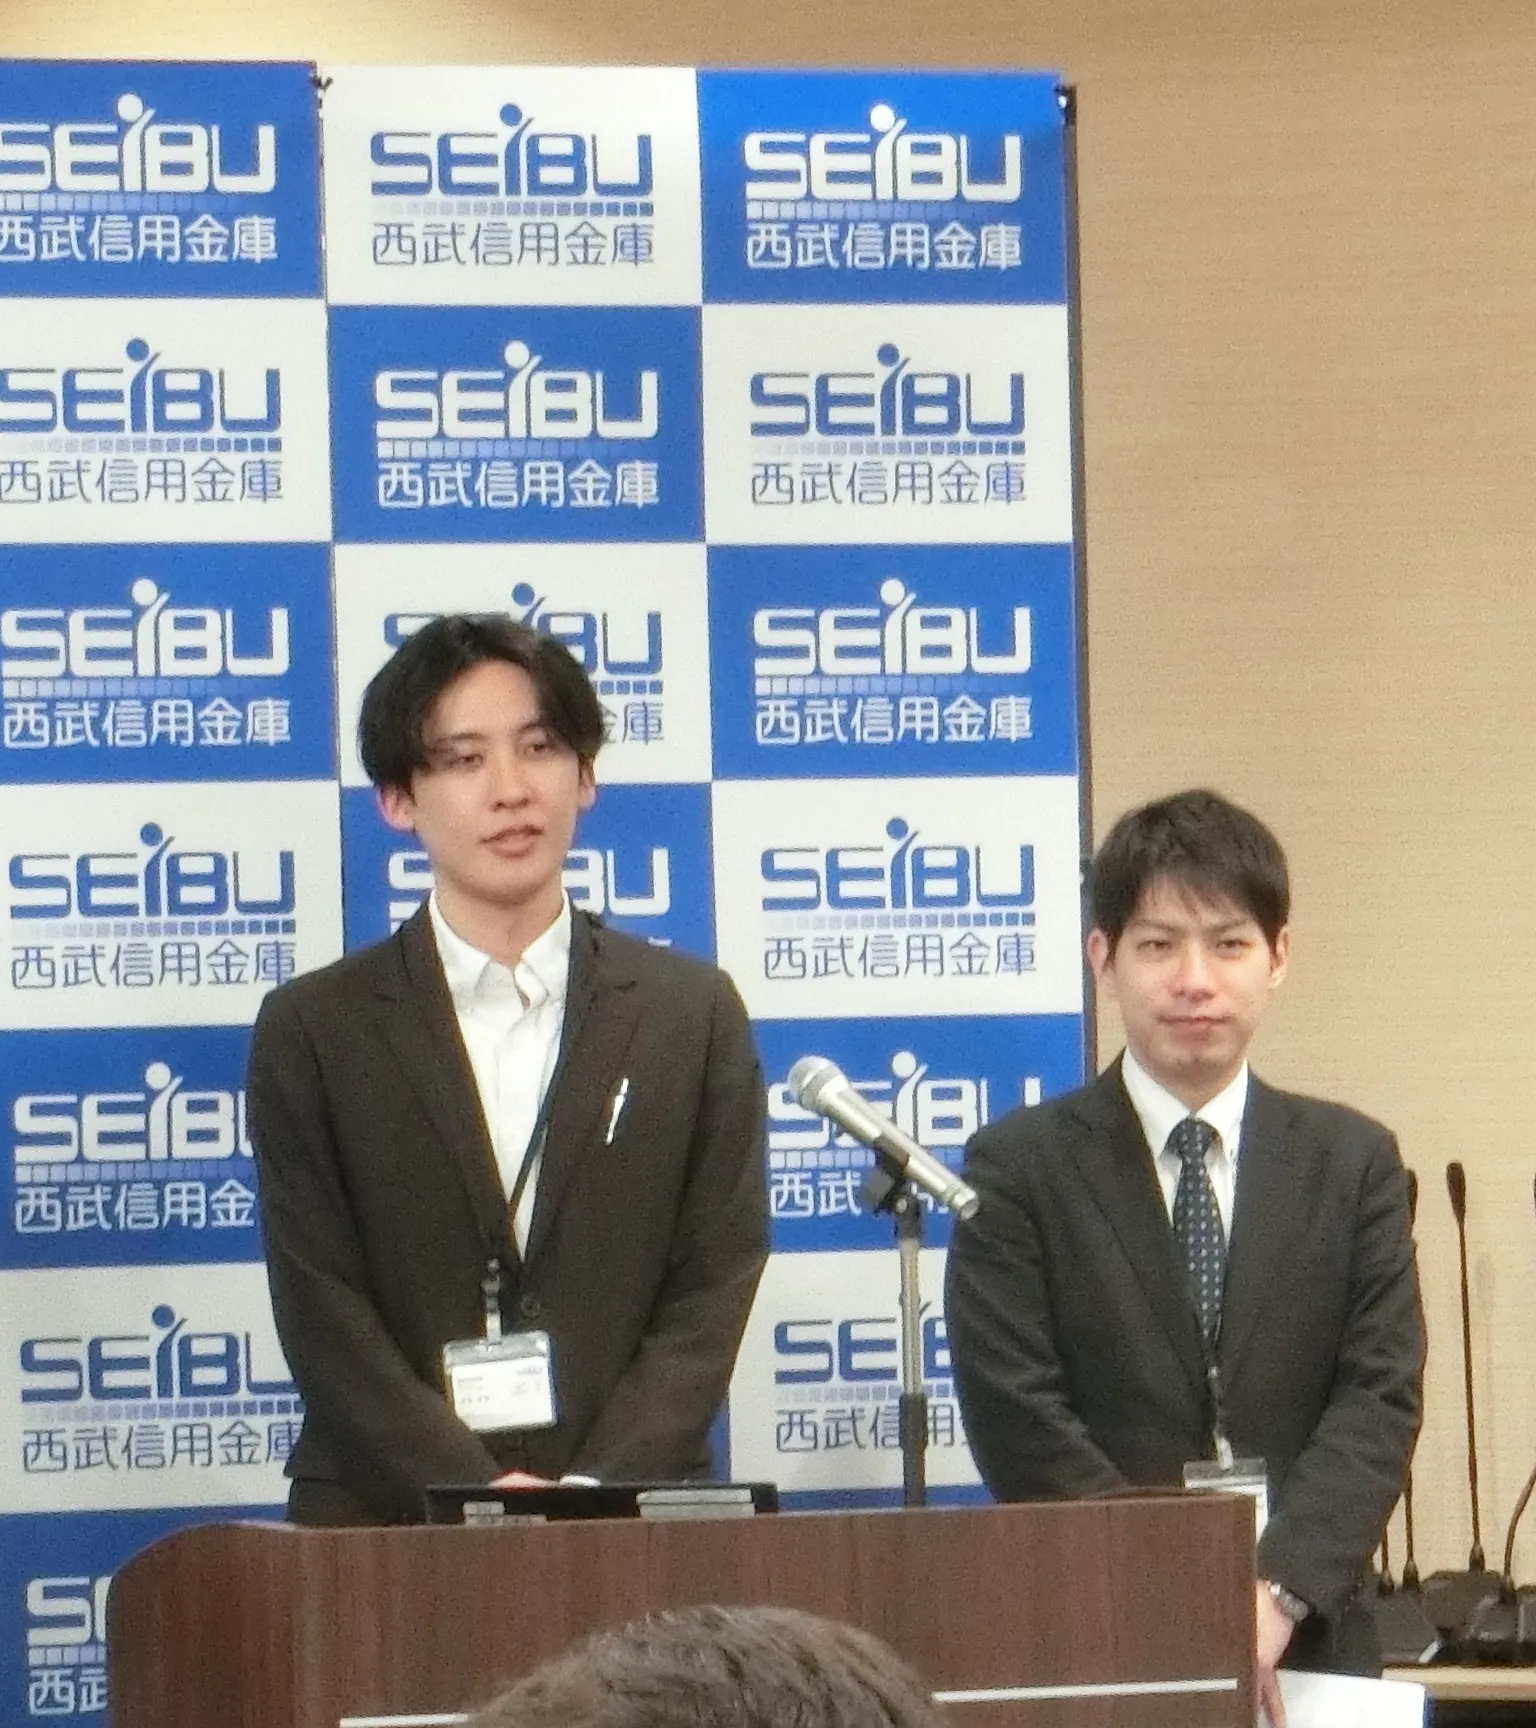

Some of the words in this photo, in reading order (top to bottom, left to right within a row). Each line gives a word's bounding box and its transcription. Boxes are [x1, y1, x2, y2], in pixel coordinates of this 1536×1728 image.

[373, 221, 653, 266] 西武信用金庫
[747, 217, 1021, 269] 西武信用金庫
[378, 457, 658, 507] 西武信用金庫
[752, 460, 1024, 504] 西武信用金庫
[3, 697, 290, 748] 西武信用金庫
[756, 695, 1031, 744] 西武信用金庫
[12, 940, 296, 992] 西武信用金庫
[764, 932, 1035, 980] 西武信用金庫
[15, 1178, 256, 1233] 西武信用金
